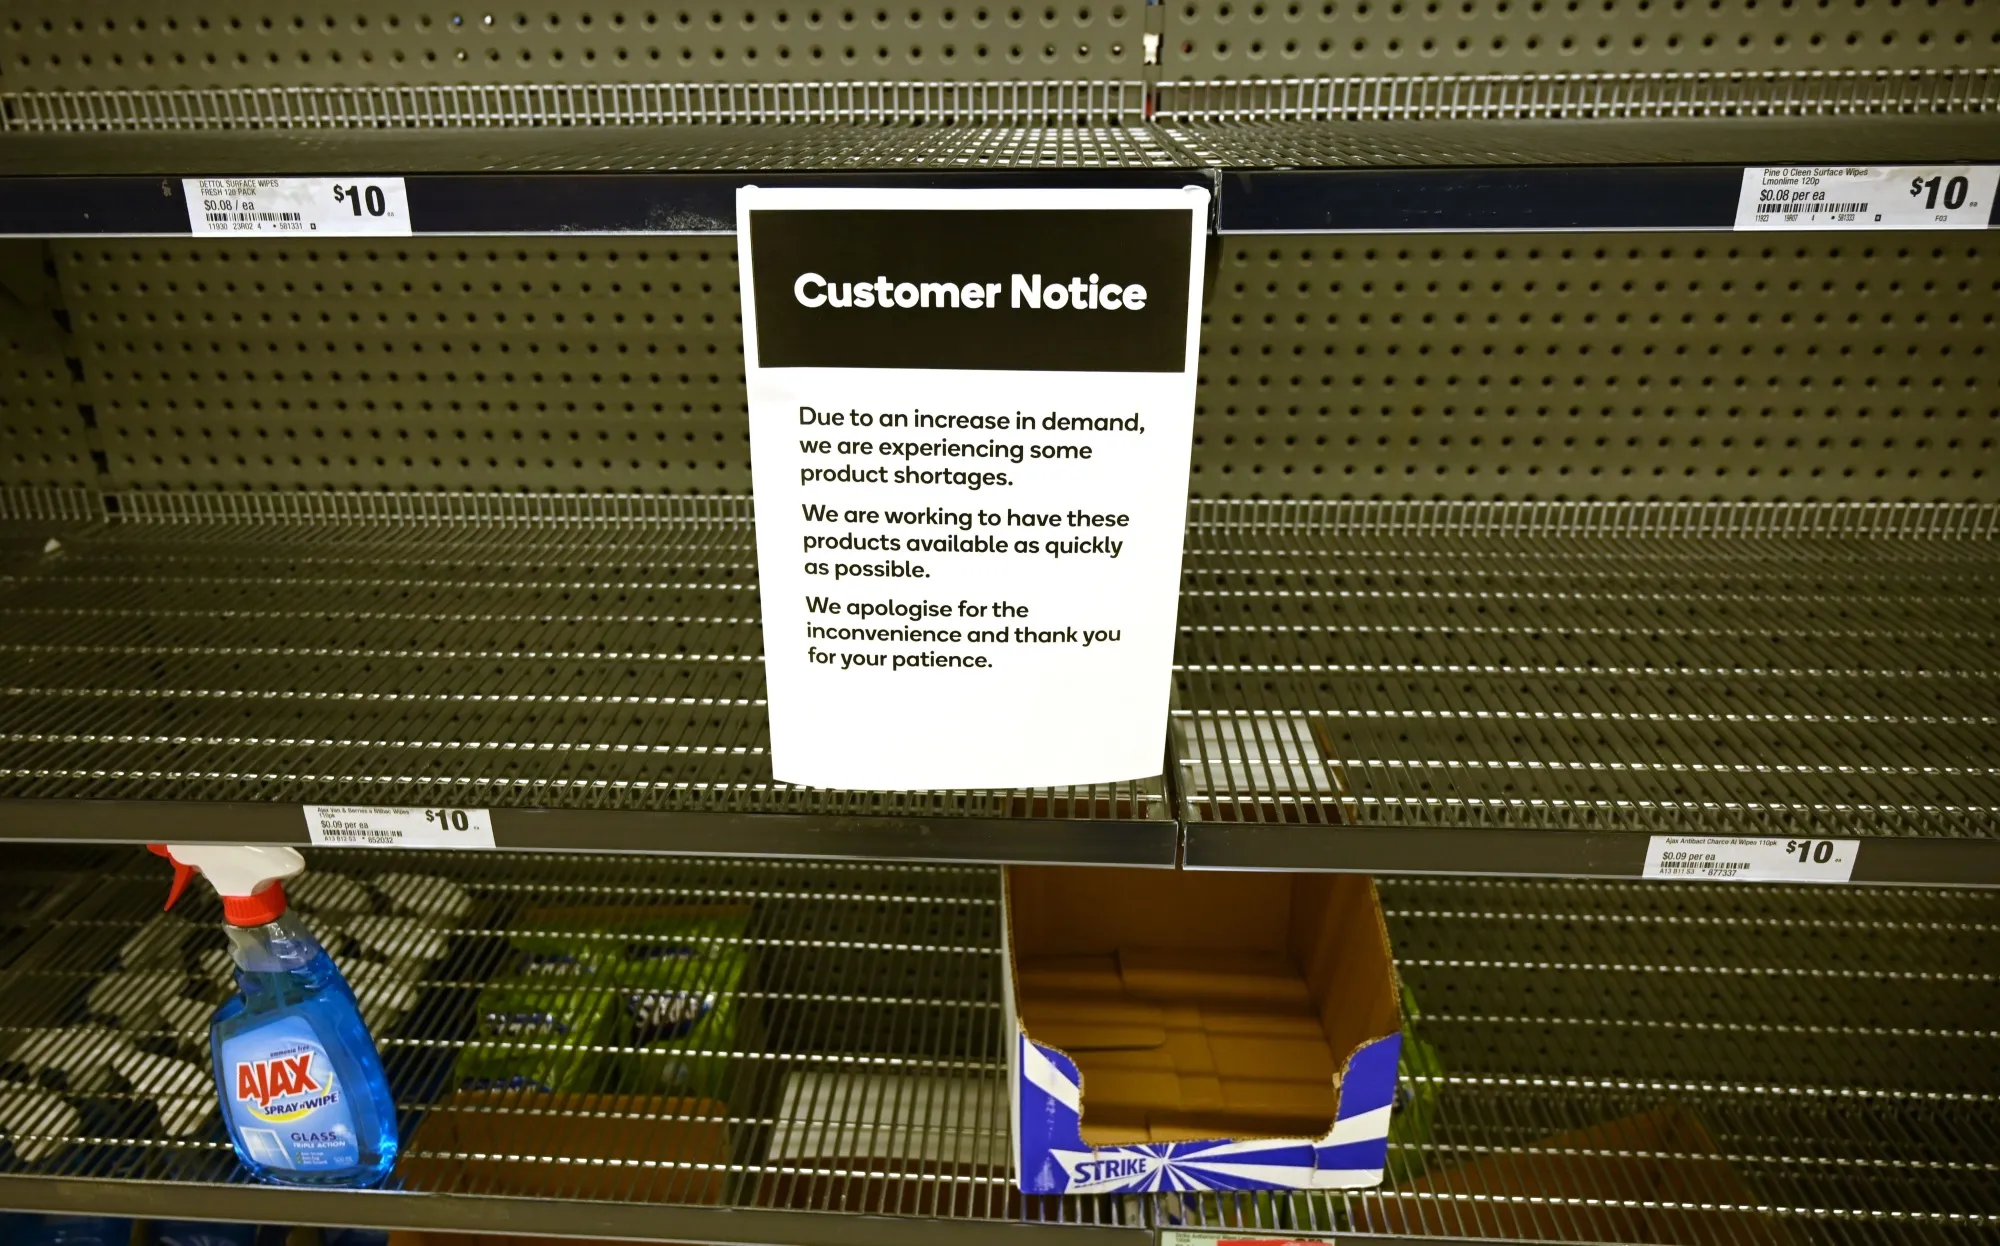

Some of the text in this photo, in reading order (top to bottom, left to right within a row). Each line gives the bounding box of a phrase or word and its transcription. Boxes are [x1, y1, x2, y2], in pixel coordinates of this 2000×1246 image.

[200, 180, 224, 188] DETTOL
[1762, 177, 1820, 186] Lmonlime 120p
[1814, 168, 1843, 176] Surface
[1846, 168, 1868, 177] Wipes
[334, 184, 385, 216] $10
[1759, 189, 1825, 203] $0.08 per ea
[1910, 176, 1968, 209] $10
[204, 199, 232, 211] $0.08
[242, 202, 255, 210] ea
[1838, 214, 1855, 222] 581333
[794, 273, 1147, 310] Customer Notice
[800, 407, 1144, 434] Due to an increase in demand,
[800, 438, 1092, 463] we are experiencing some
[801, 464, 1013, 490] product shortages.
[802, 504, 1129, 530] We are working to have these
[804, 532, 1123, 558] products available as quickly
[805, 560, 930, 580] as possible.
[806, 596, 1028, 621] We apologise for the
[807, 622, 1120, 647] inconvenience and thank you
[808, 647, 992, 671] for your patience.
[345, 822, 356, 830] per
[426, 809, 468, 831] $10
[1666, 838, 1678, 846] Ajax
[1786, 840, 1834, 864] $10
[1663, 852, 1686, 860] $0.09
[1688, 853, 1703, 862] per
[238, 1053, 318, 1106] AJAX
[265, 1102, 298, 1116] SPRAY
[291, 1131, 336, 1141] GLASS
[1074, 1158, 1146, 1184] STRIKE
